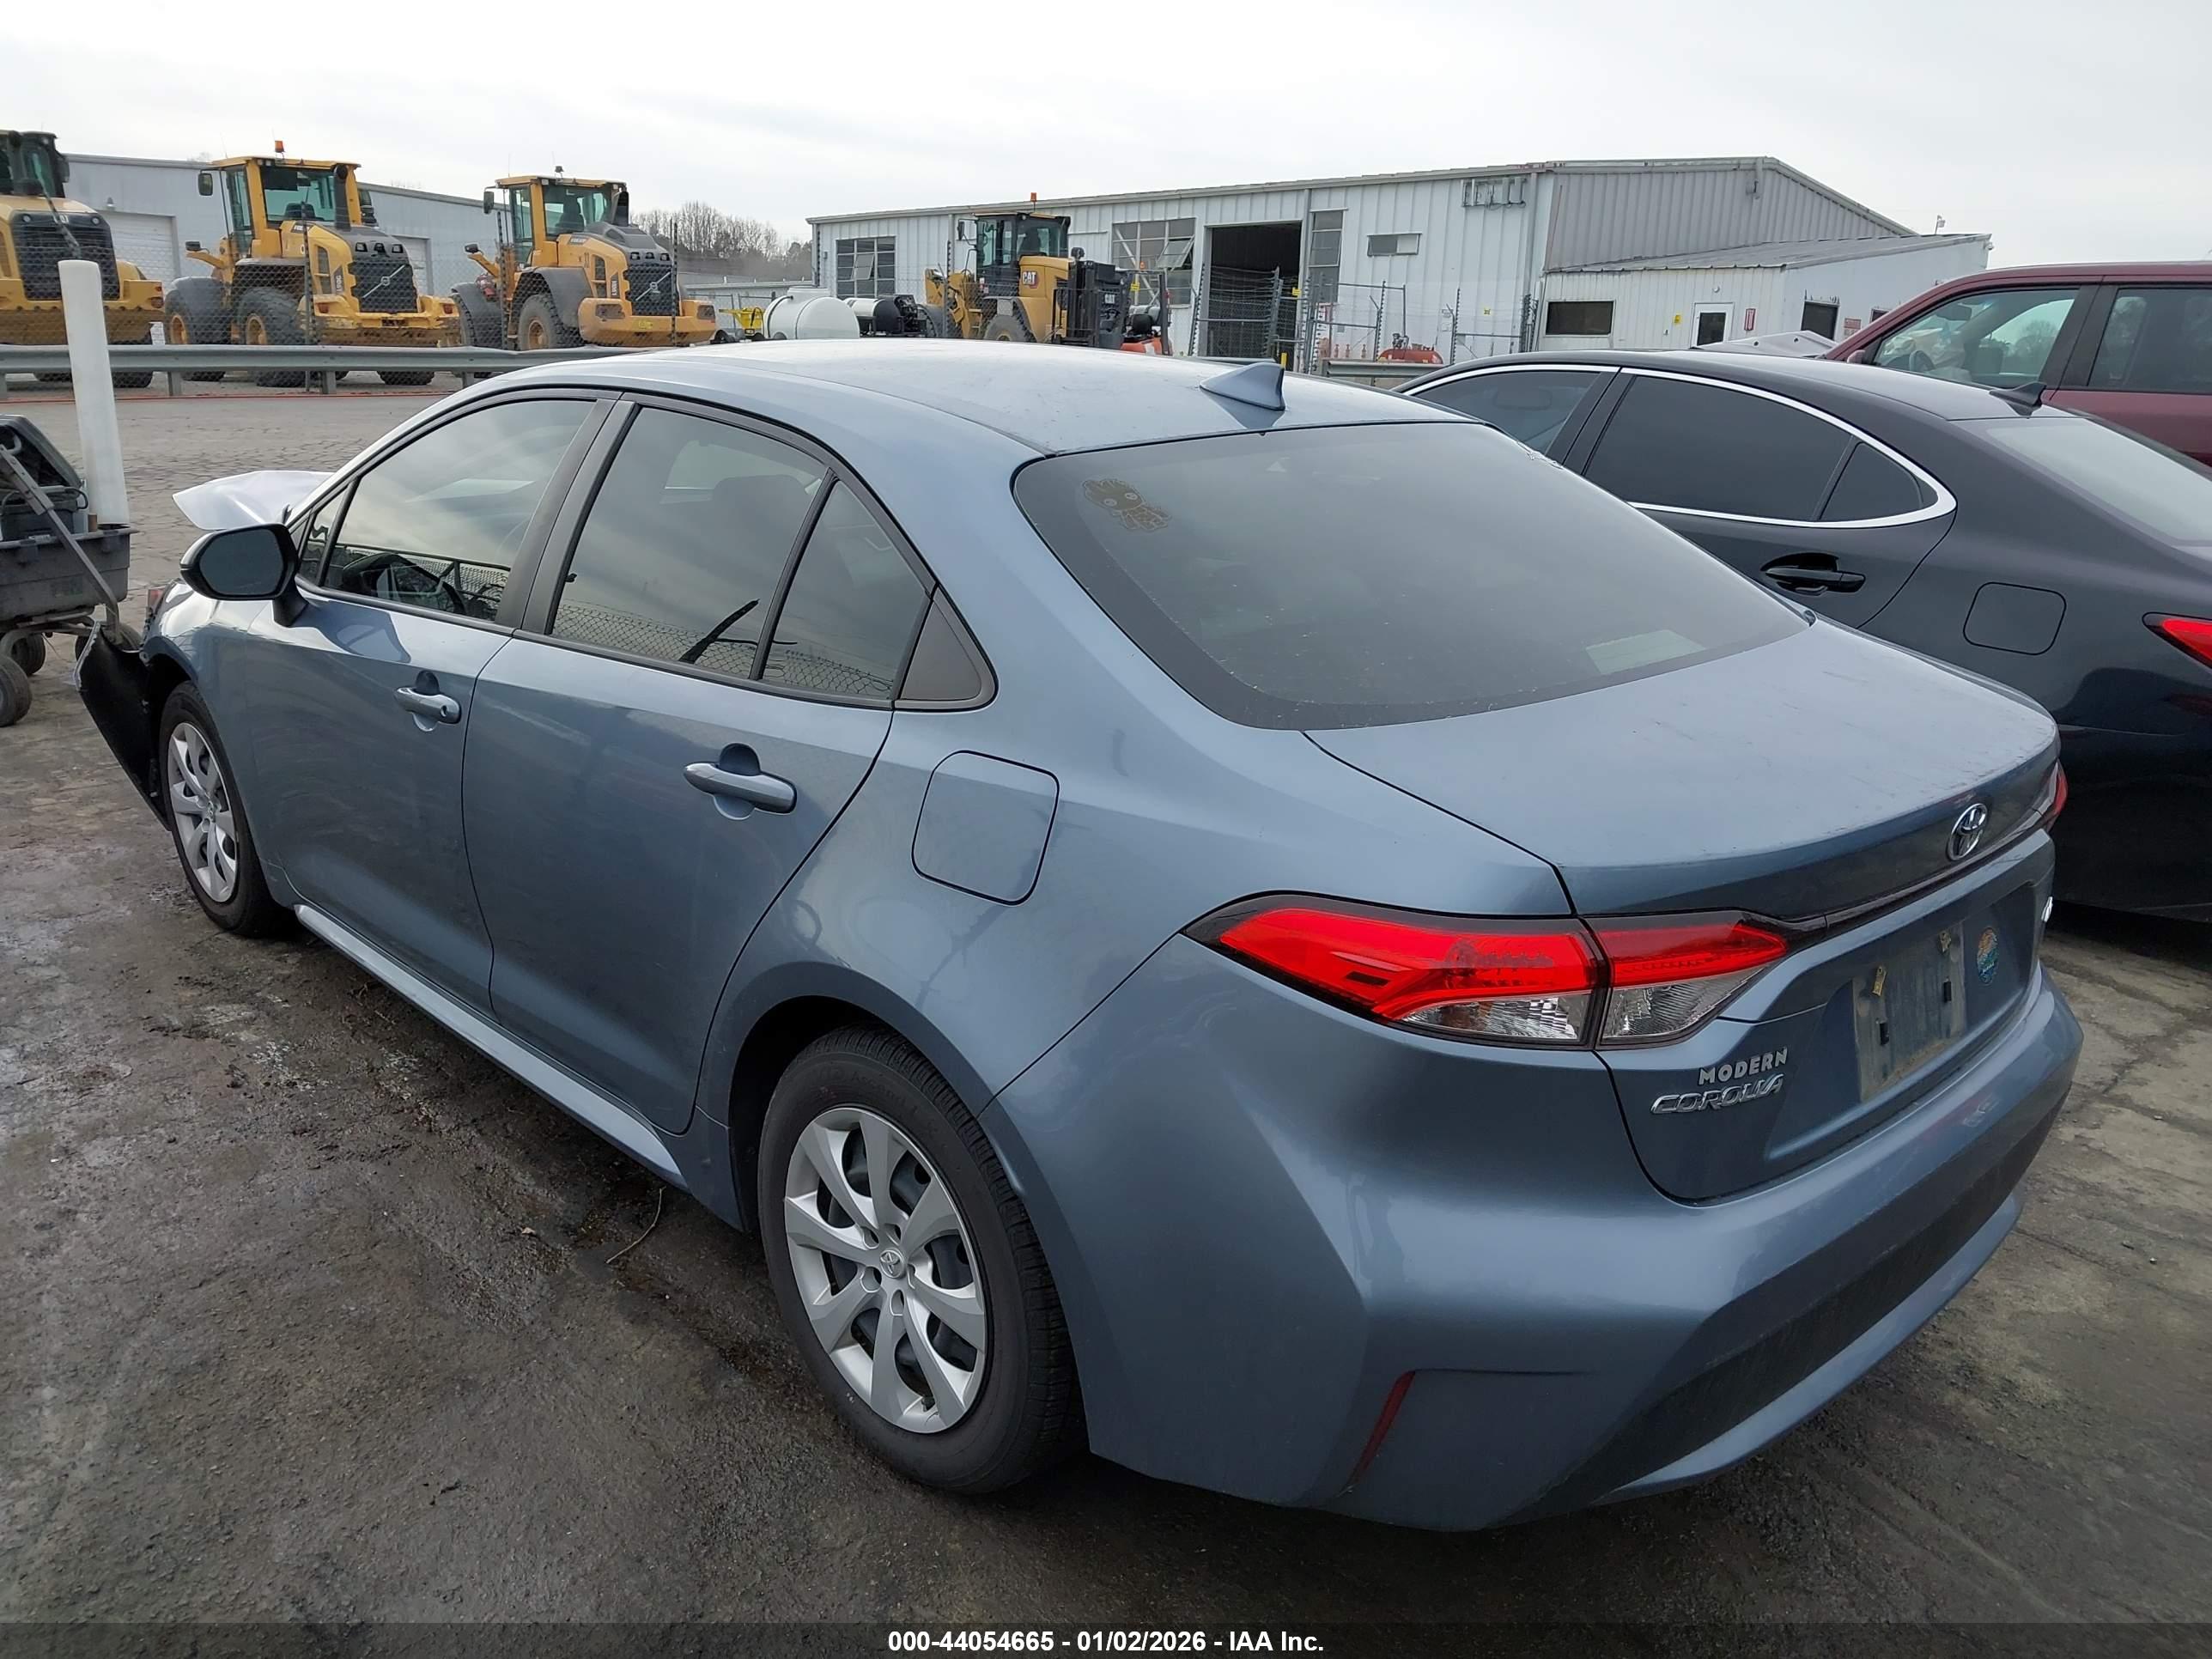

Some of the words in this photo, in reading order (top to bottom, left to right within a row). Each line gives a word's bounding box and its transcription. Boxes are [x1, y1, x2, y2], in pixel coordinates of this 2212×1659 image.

[1022, 271, 1036, 285] CAT
[1104, 294, 1115, 304] CAT
[1698, 1048, 1788, 1085] MODERN
[1650, 1073, 1784, 1114] COROLLA
